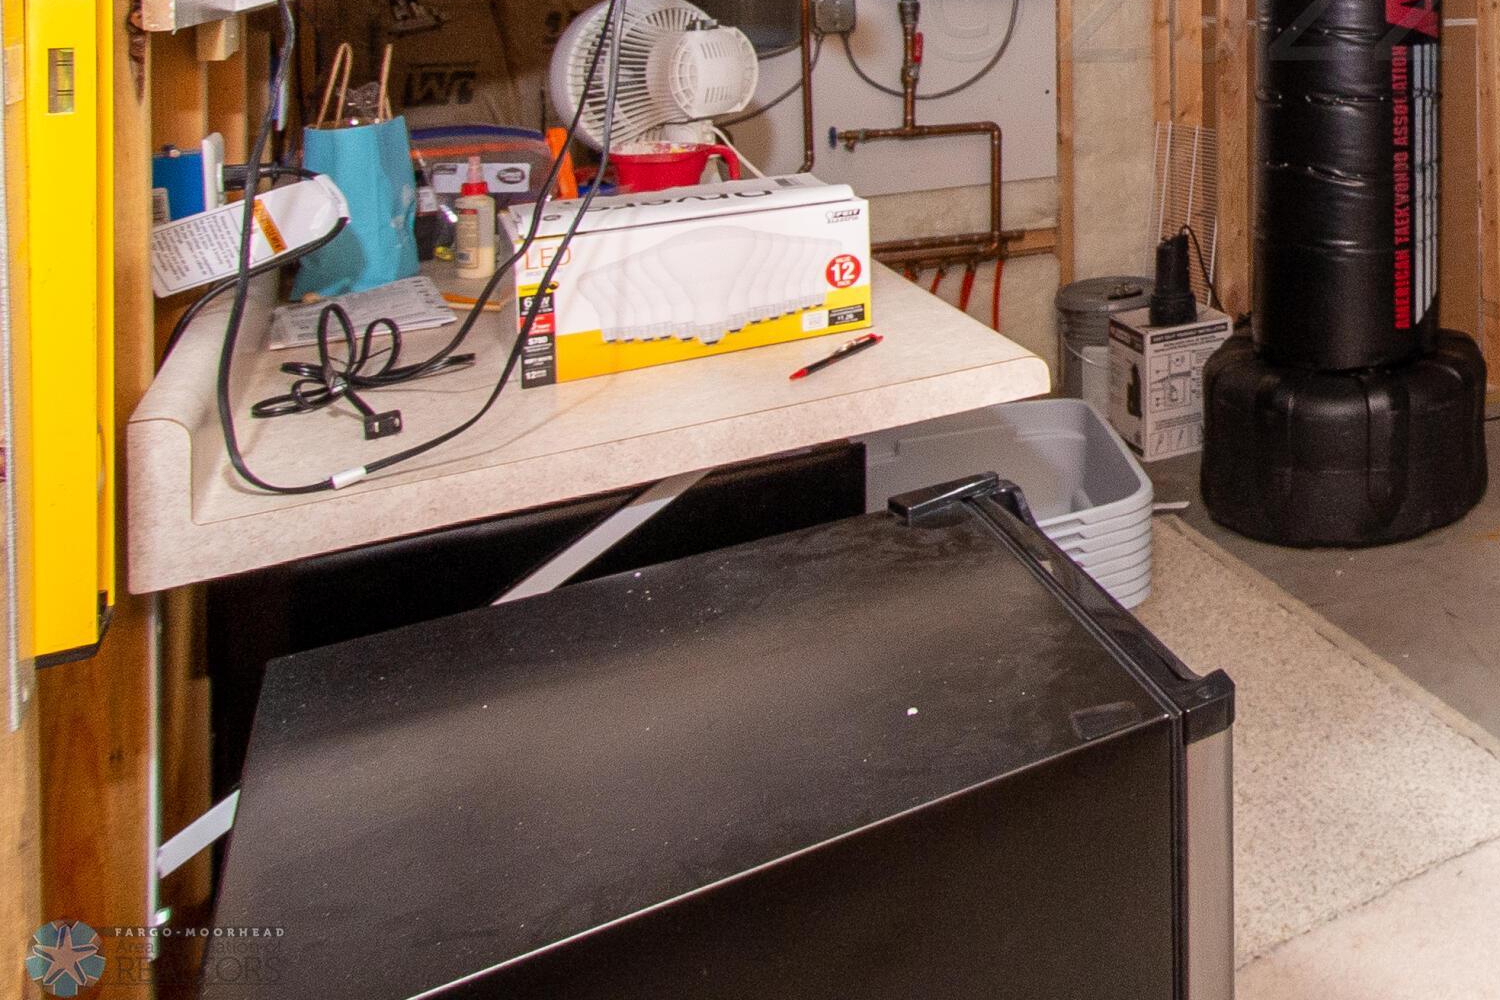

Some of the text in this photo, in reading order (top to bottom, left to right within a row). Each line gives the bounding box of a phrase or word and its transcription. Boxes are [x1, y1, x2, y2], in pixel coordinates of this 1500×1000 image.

[1393, 151, 1410, 246] TAEKWONDO
[524, 246, 572, 271] LED
[830, 260, 855, 282] 12
[1394, 249, 1411, 330] AMERICAN
